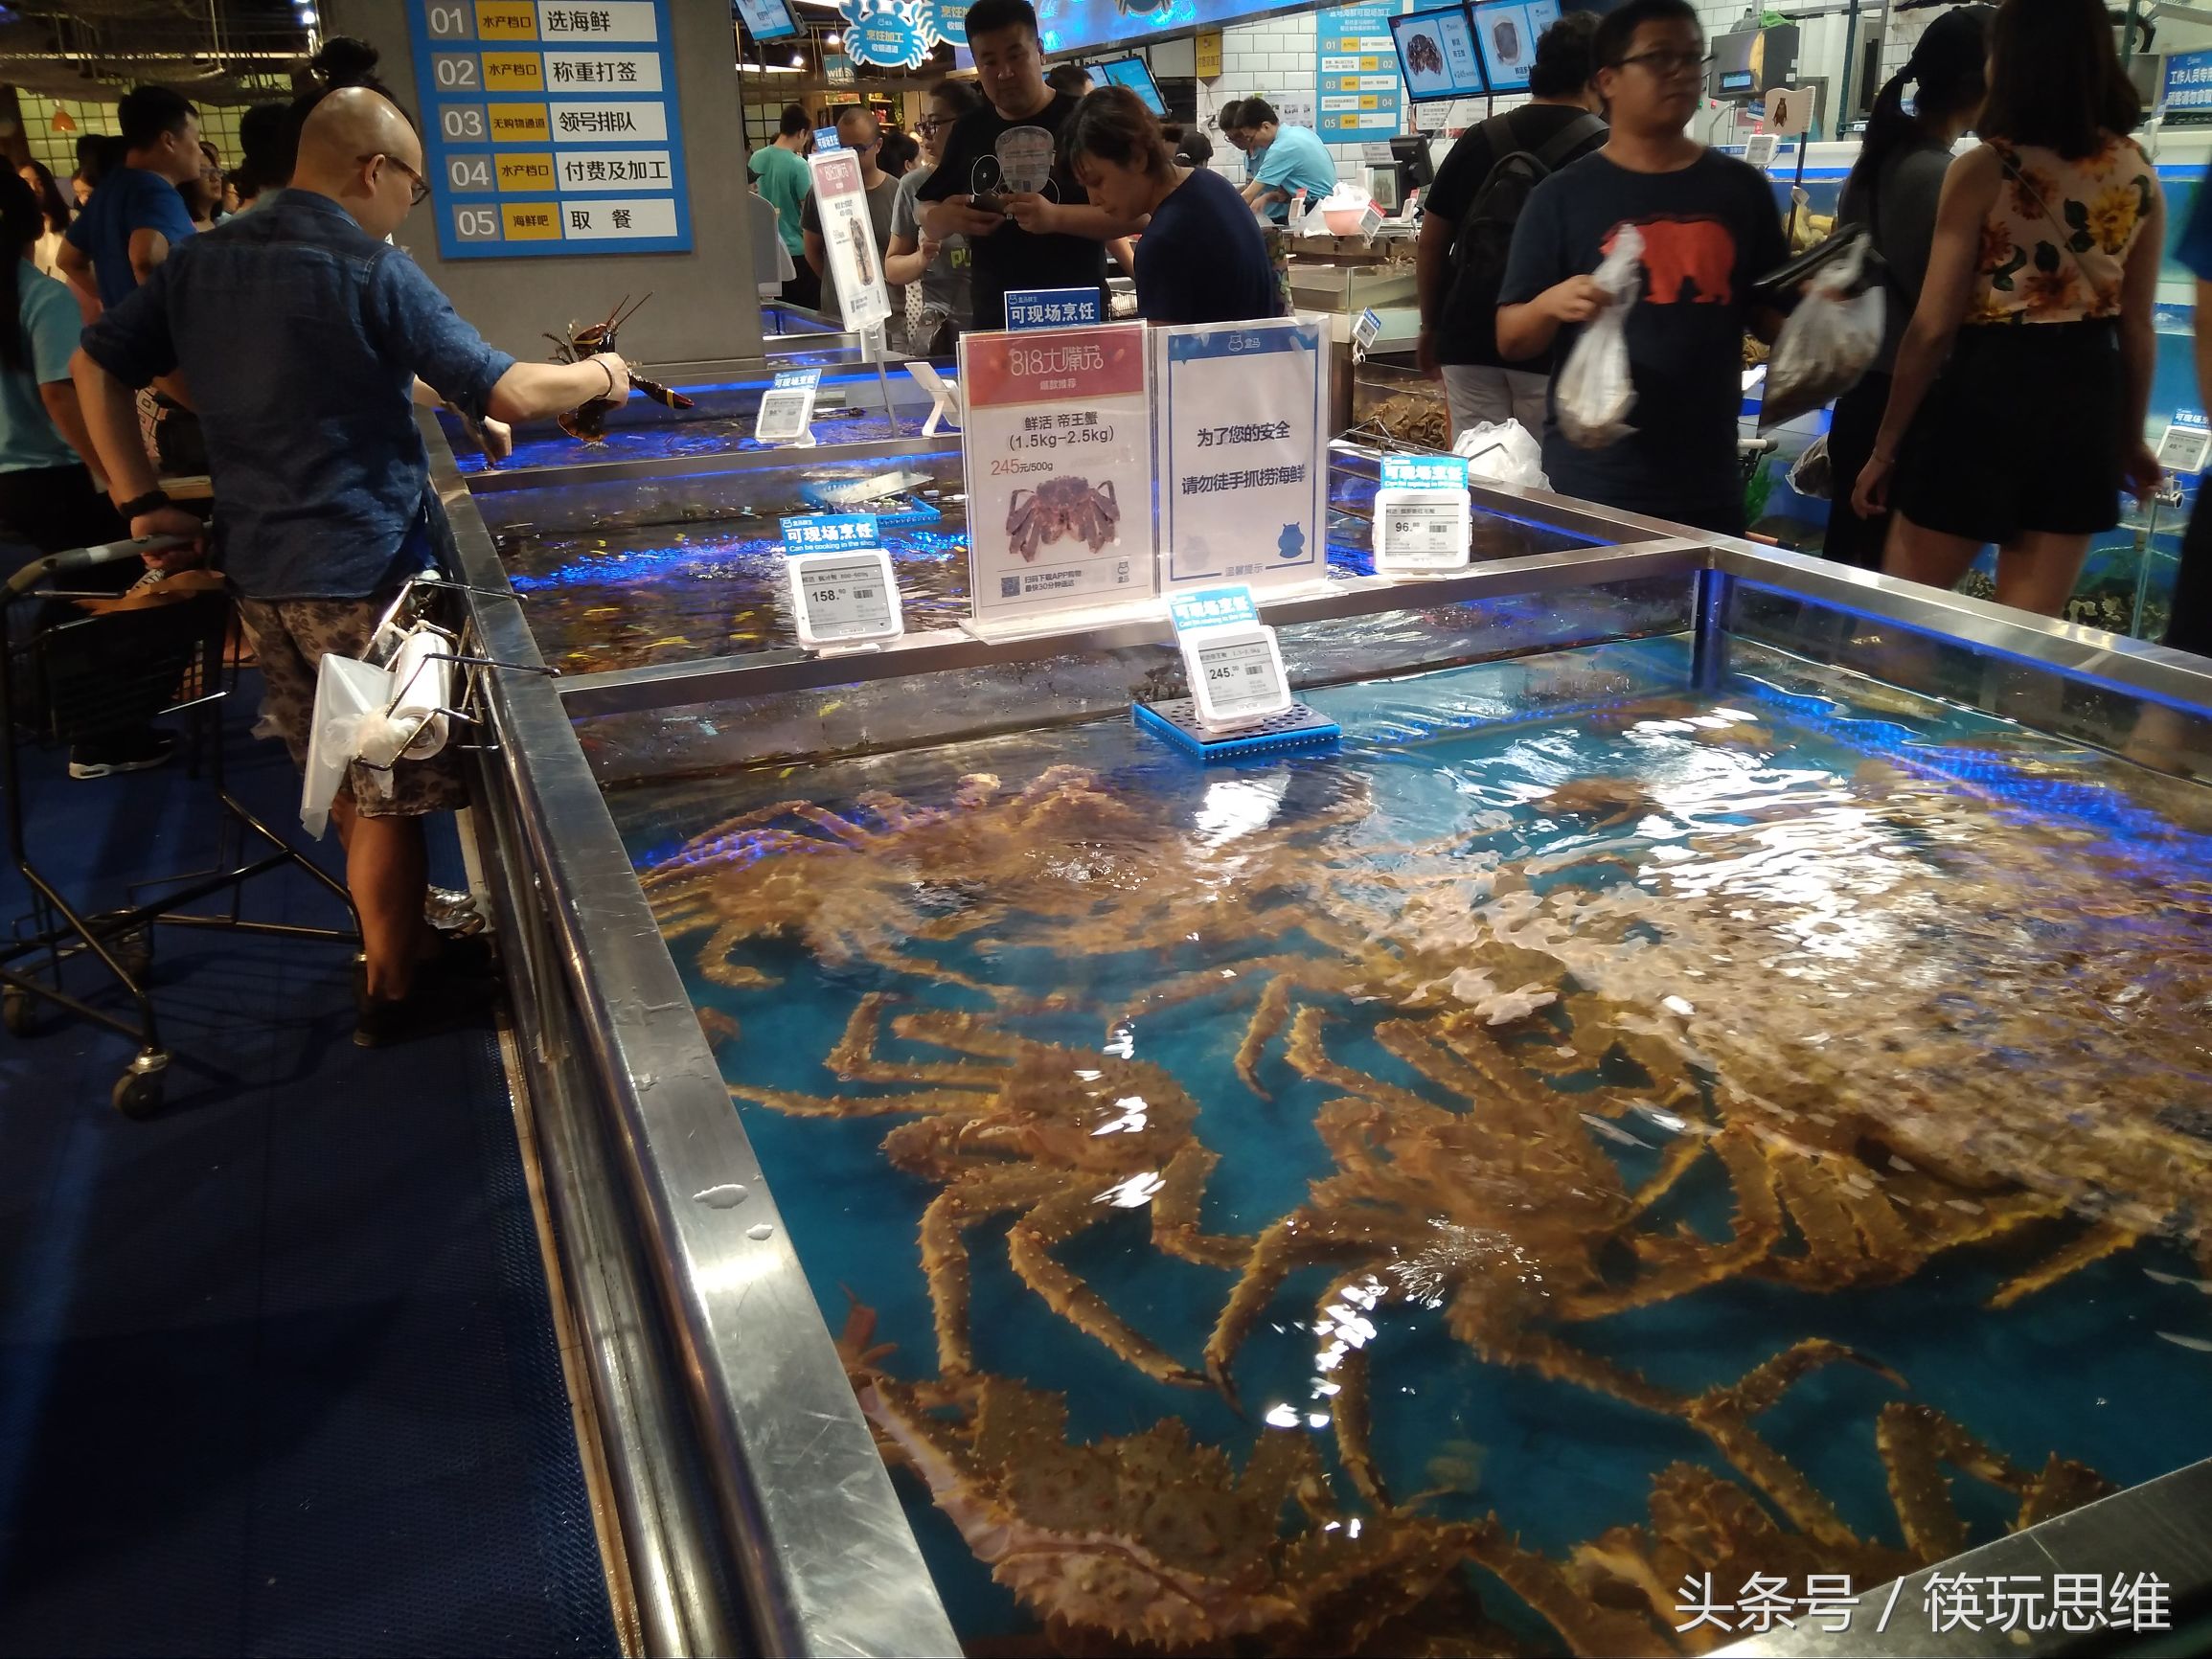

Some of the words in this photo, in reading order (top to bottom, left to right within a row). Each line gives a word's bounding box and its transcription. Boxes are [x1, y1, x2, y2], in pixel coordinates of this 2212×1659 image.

[431, 8, 464, 34] 01
[482, 15, 532, 29] 水产档口
[548, 11, 611, 32] 选海鲜
[866, 30, 904, 43] 烹饪加工
[1326, 41, 1335, 50] 01
[437, 59, 476, 85] 02
[489, 63, 537, 77] 水产档口
[553, 61, 638, 82] 称重打签
[1382, 60, 1393, 69] 02
[1325, 80, 1335, 89] 03
[1381, 99, 1393, 107] 04
[445, 110, 483, 136] 03
[493, 118, 546, 129] 无购物通道
[559, 111, 637, 132] 领号排队
[1324, 119, 1335, 127] 05
[450, 161, 490, 187] 04
[501, 165, 549, 176] 水产档口
[565, 160, 669, 182] 付费及加工
[458, 211, 496, 236] 05
[513, 215, 550, 227] 海鲜吧
[1010, 302, 1095, 325] 可现场烹饪
[1024, 415, 1053, 431] 鲜活
[1057, 411, 1099, 428] 帝王蟹
[1009, 425, 1114, 451] (1.5kg-2.5kg)
[1197, 420, 1290, 447] 为了您的安全
[1181, 464, 1306, 495] 请勿徒手抓捞海鲜
[786, 523, 874, 544] 可现场烹饪
[1224, 562, 1266, 578] 温馨提示
